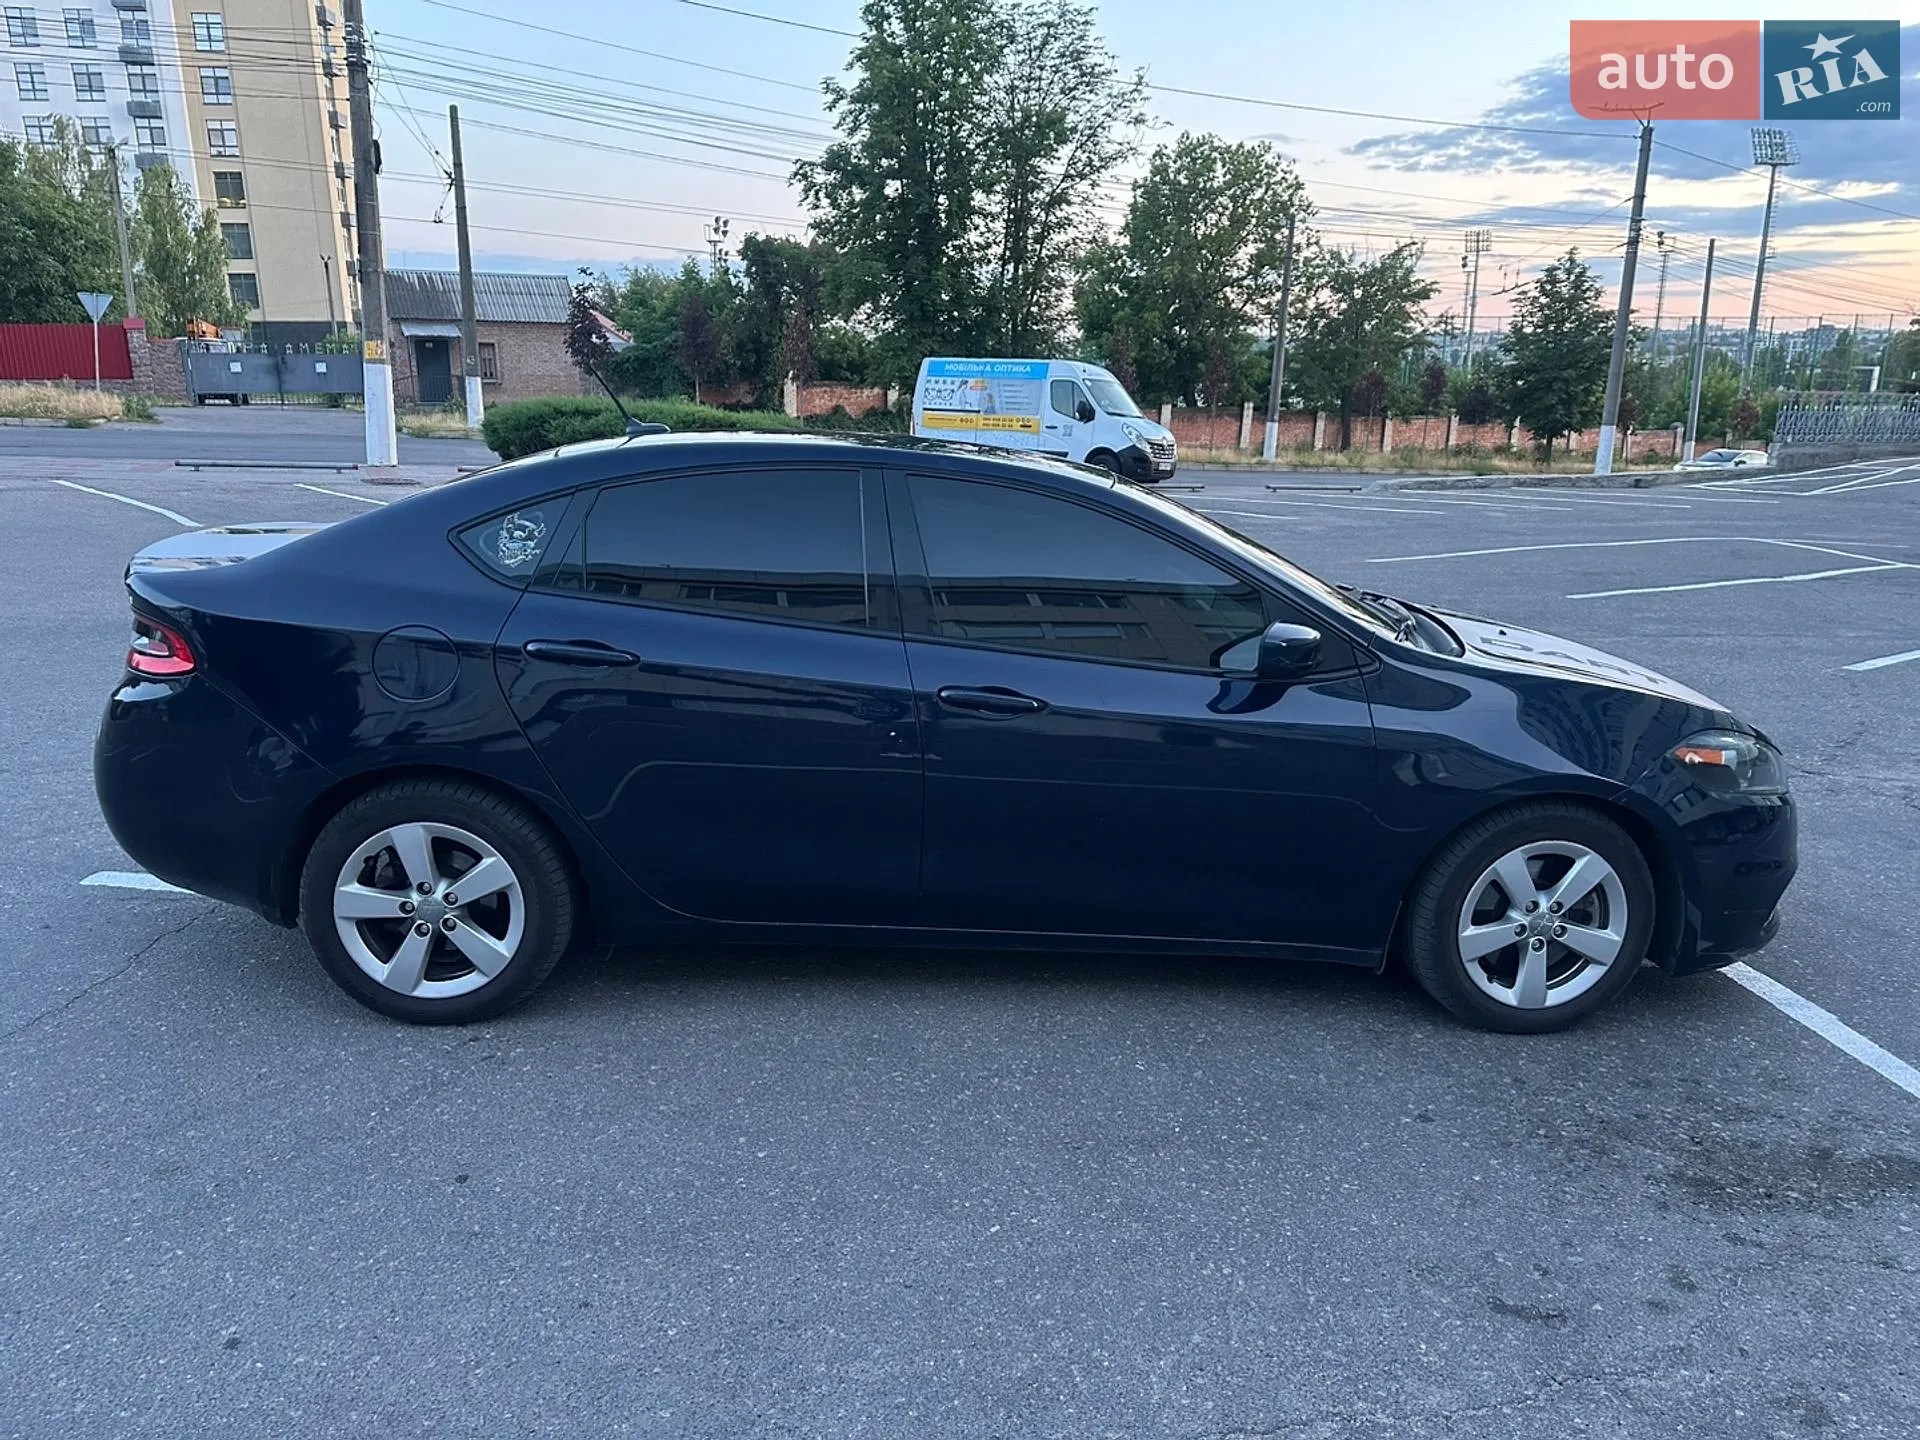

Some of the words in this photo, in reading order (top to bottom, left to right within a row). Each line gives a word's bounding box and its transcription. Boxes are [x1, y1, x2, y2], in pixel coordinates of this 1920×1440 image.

[944, 362, 992, 373] МОБІЛЬНА
[993, 363, 1031, 374] ОПТИКА
[1479, 636, 1667, 685] DART
